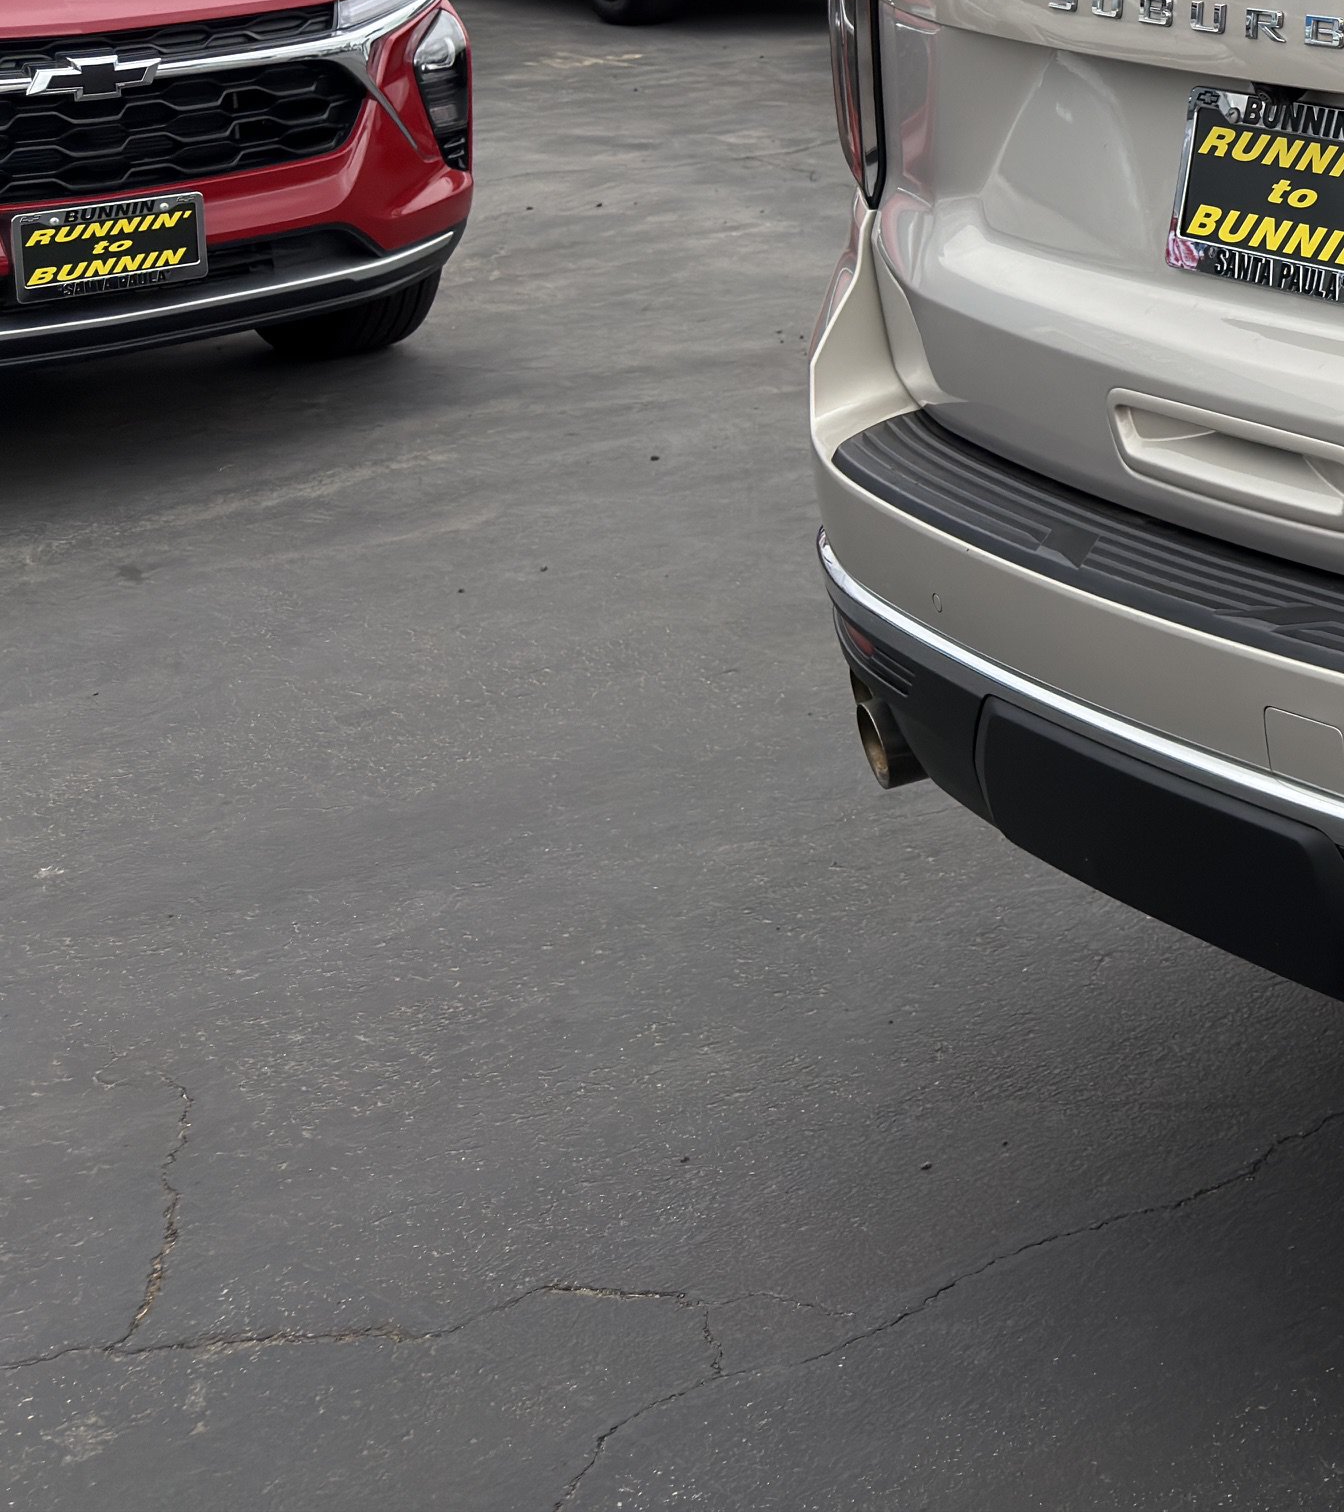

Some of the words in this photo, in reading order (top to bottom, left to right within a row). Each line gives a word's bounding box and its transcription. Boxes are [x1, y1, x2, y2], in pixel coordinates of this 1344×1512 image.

[1266, 178, 1319, 209] to
[63, 199, 156, 224] BUNNIN
[24, 210, 193, 248] RUNNIN'
[91, 239, 134, 255] to
[26, 247, 187, 287] BUNNIN
